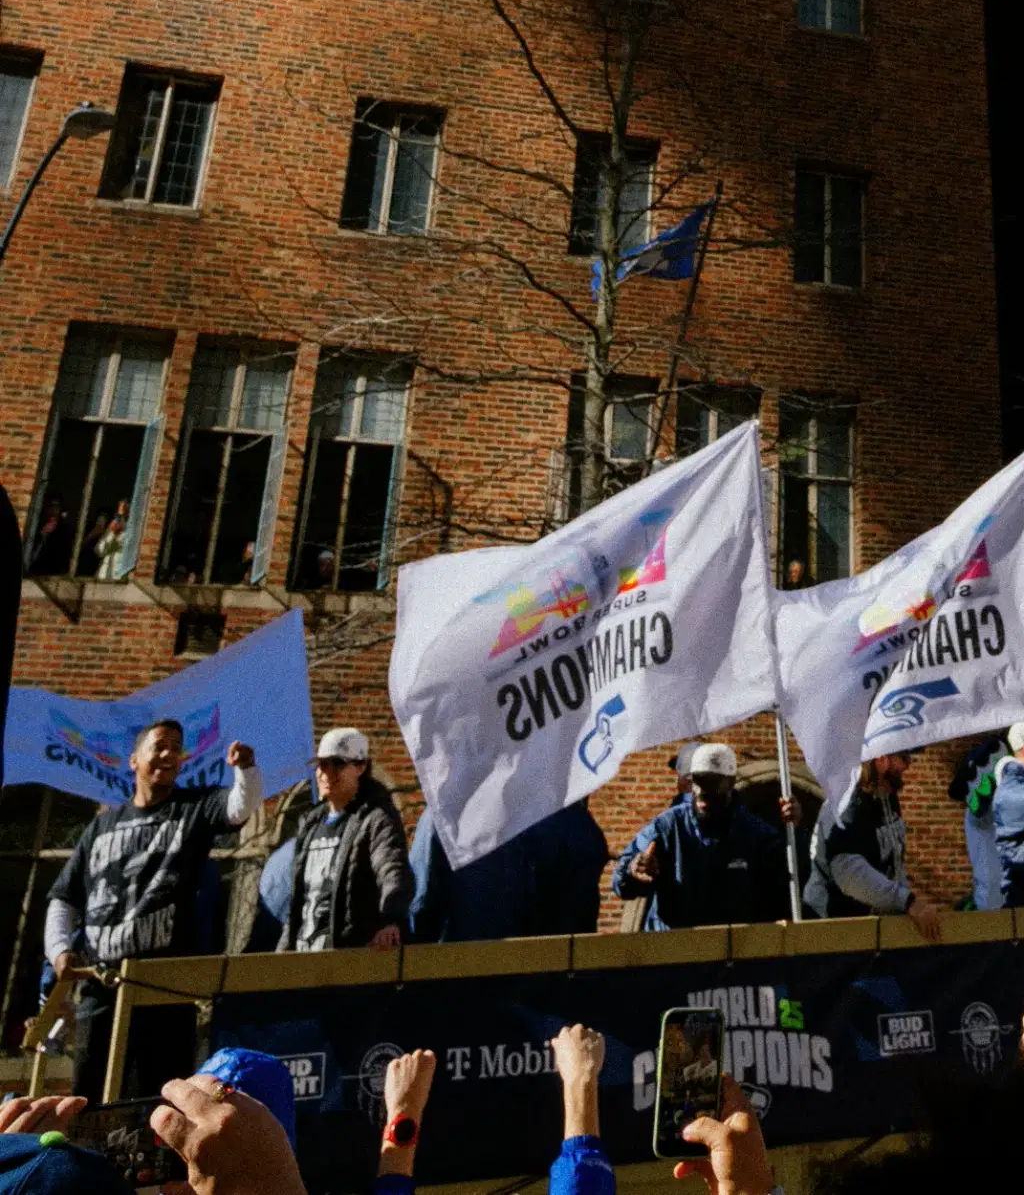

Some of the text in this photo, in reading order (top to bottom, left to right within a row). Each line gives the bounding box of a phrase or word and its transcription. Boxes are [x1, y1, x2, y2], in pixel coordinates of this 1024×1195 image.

[779, 999, 804, 1029] 25
[888, 1016, 923, 1034] BUD
[883, 1031, 931, 1050] LIGHT
[479, 1040, 559, 1080] Mobi
[633, 1029, 833, 1111] CPIONS
